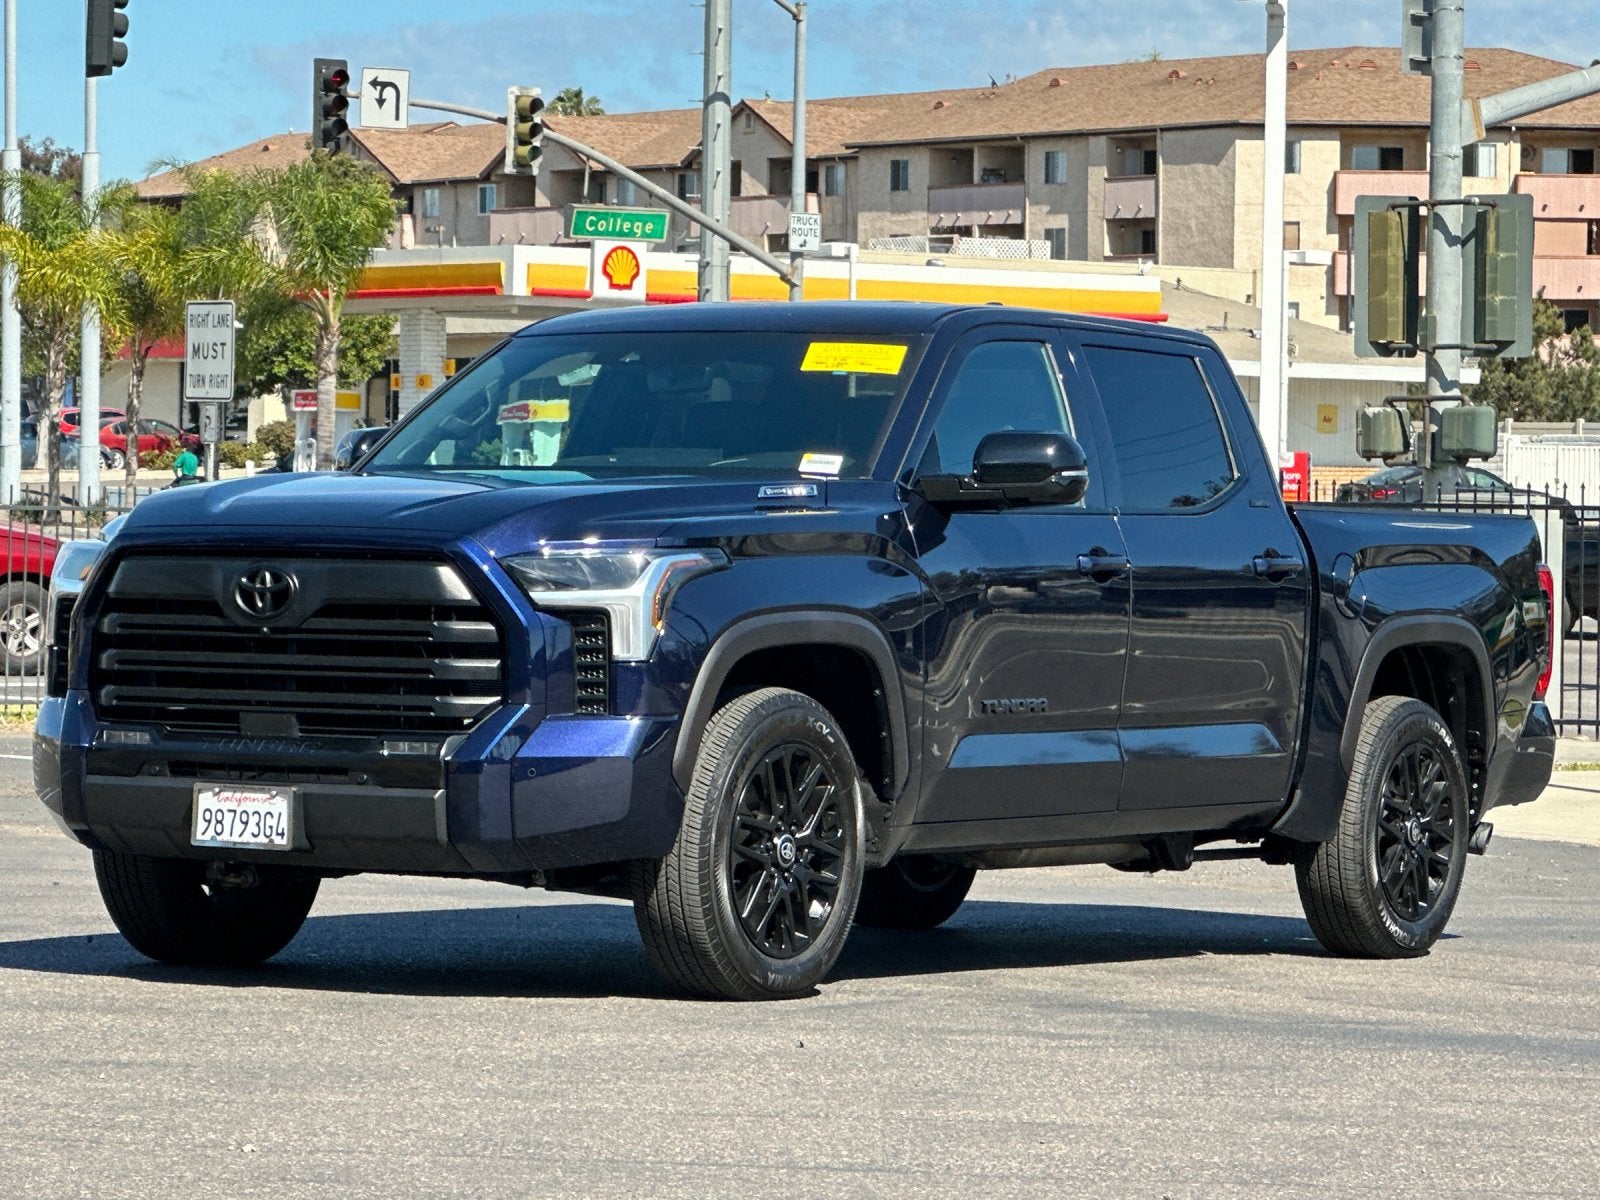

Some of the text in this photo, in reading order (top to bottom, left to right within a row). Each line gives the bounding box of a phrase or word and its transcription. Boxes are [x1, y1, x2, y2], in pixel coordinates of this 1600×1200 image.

[585, 215, 653, 237] College
[791, 215, 819, 226] TRUCK
[791, 227, 819, 238] ROUTE
[189, 313, 230, 328] RIGHT LANE
[192, 342, 227, 360] MUST
[189, 374, 229, 389] TURN RIGHT
[419, 375, 425, 386] 6
[1322, 415, 1333, 423] Air
[981, 698, 1048, 714] TUNDRA
[216, 790, 277, 807] California
[201, 807, 285, 840] 98793G4
